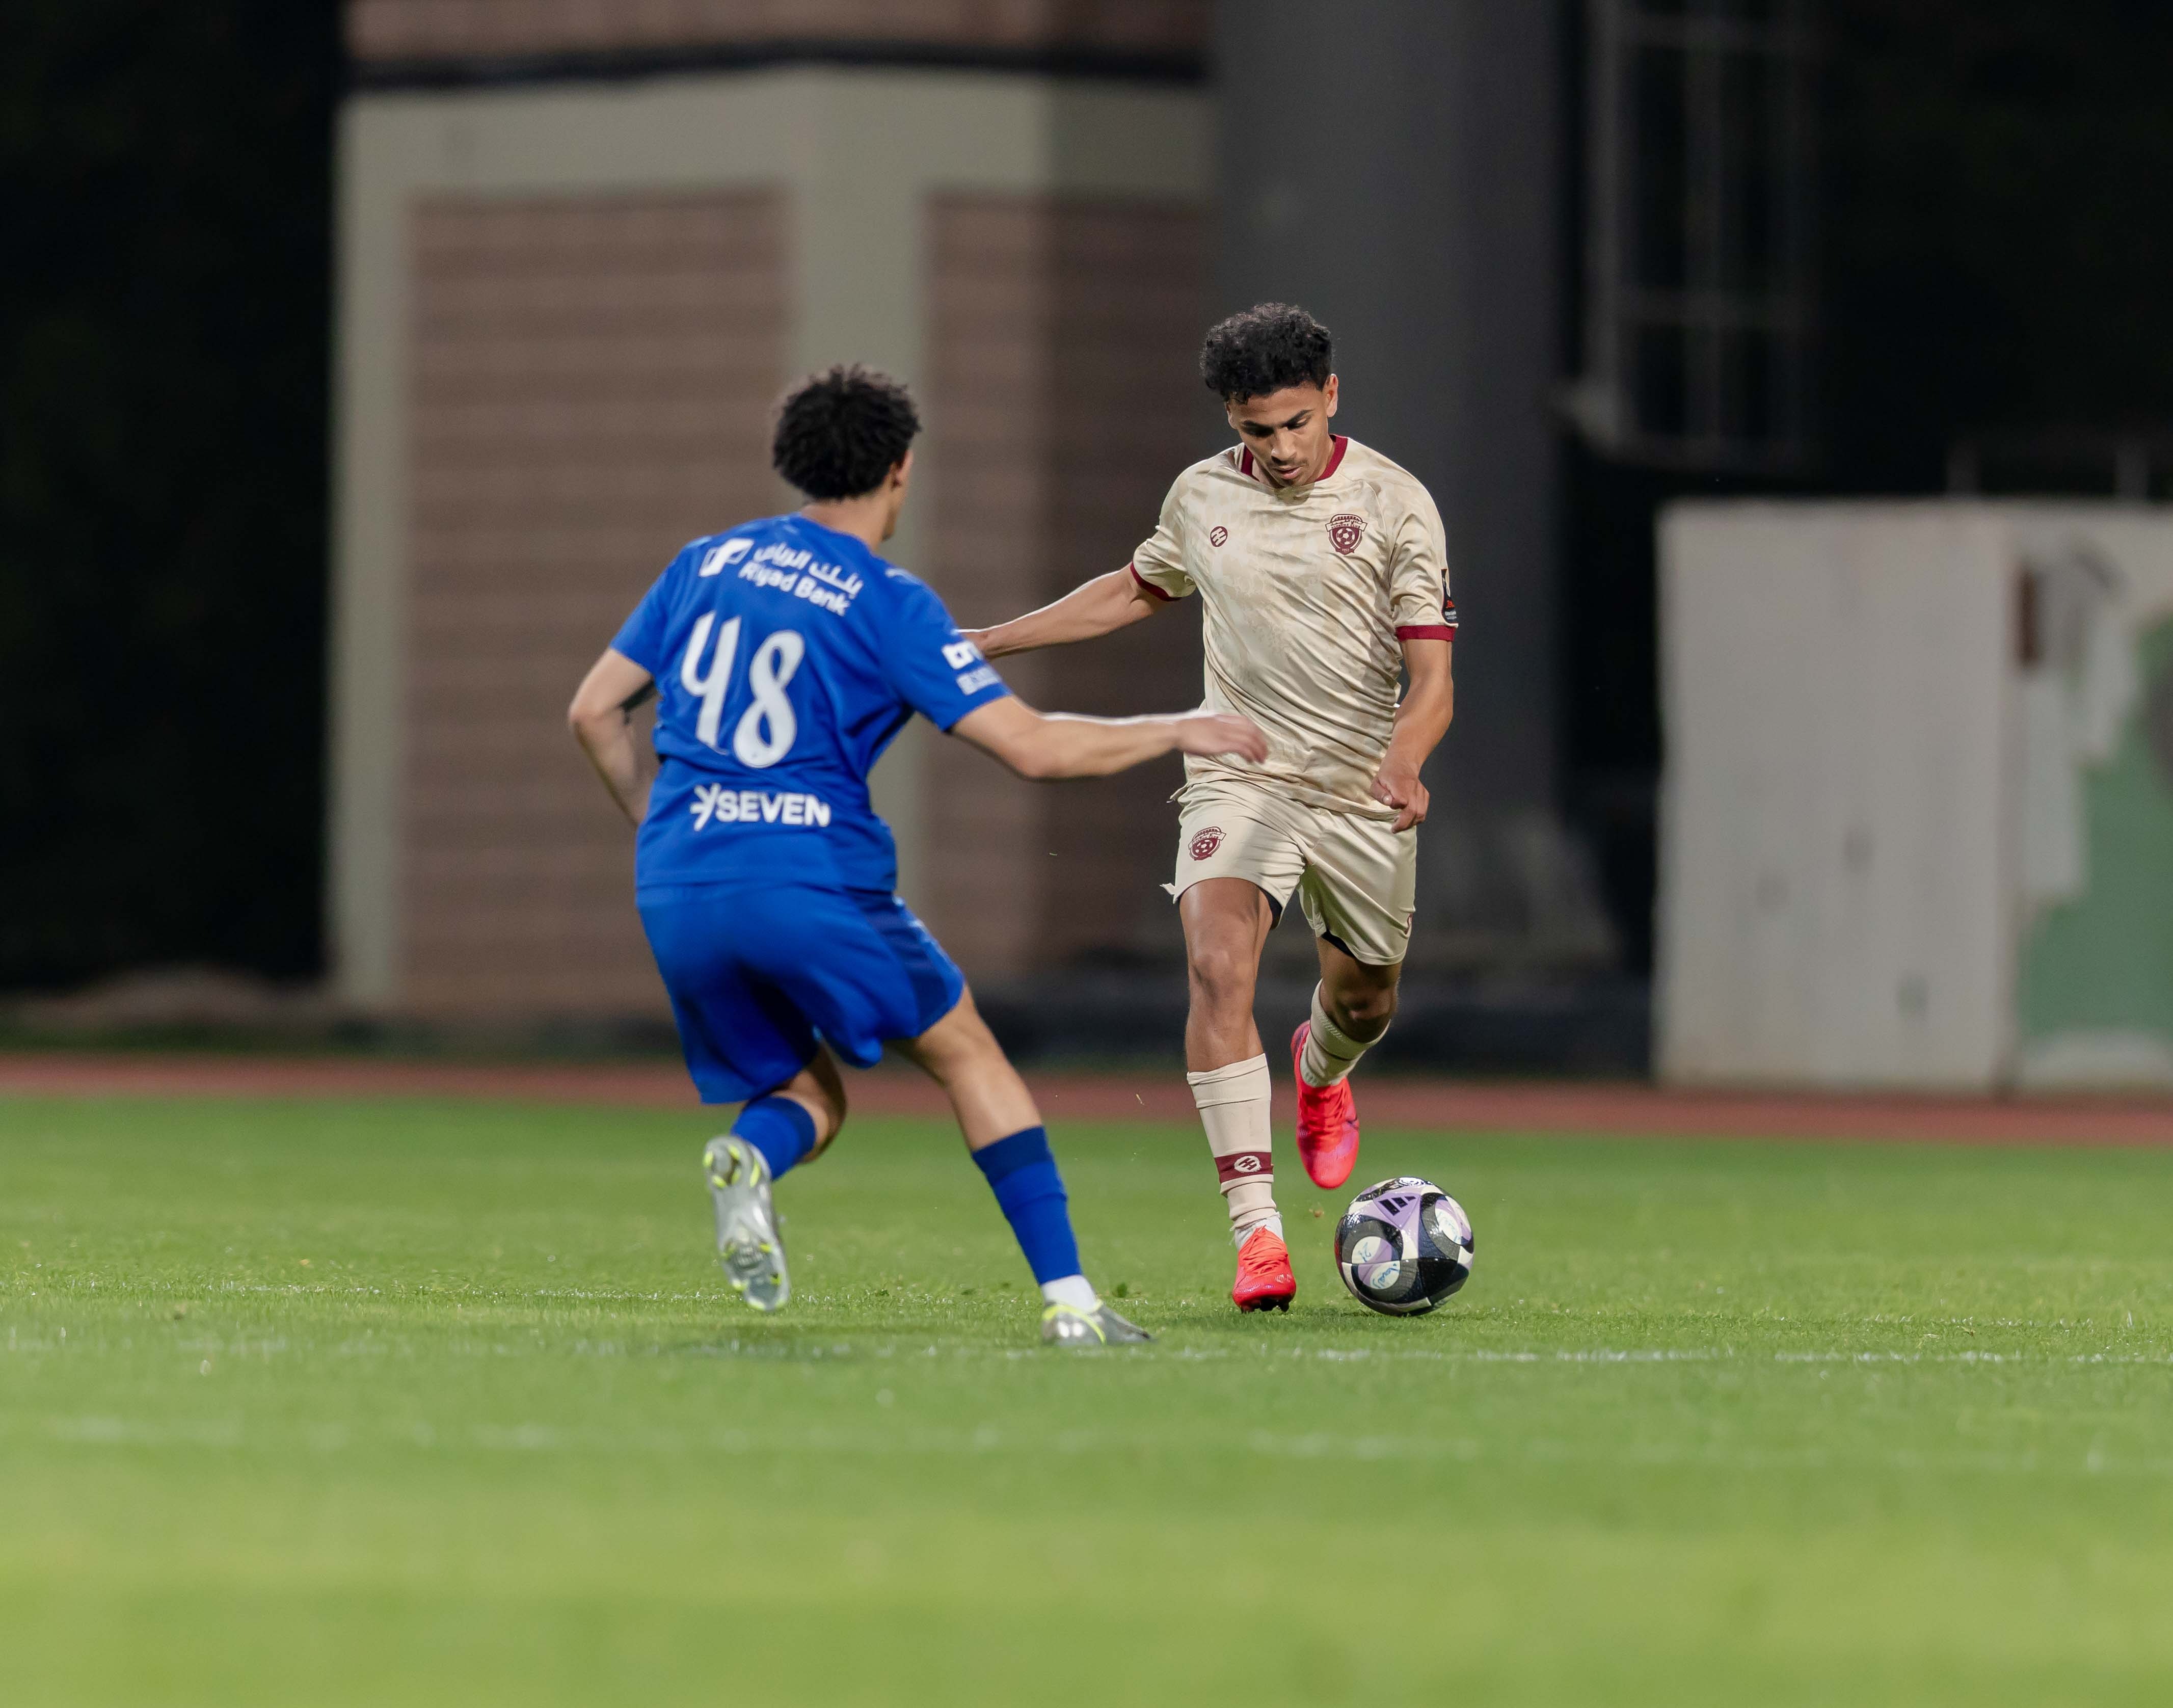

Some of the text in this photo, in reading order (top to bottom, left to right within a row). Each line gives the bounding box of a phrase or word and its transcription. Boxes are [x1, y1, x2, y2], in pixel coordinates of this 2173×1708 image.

[738, 561, 851, 617] Riyad Bank
[680, 610, 805, 768] 48
[715, 790, 831, 828] SEVEN
